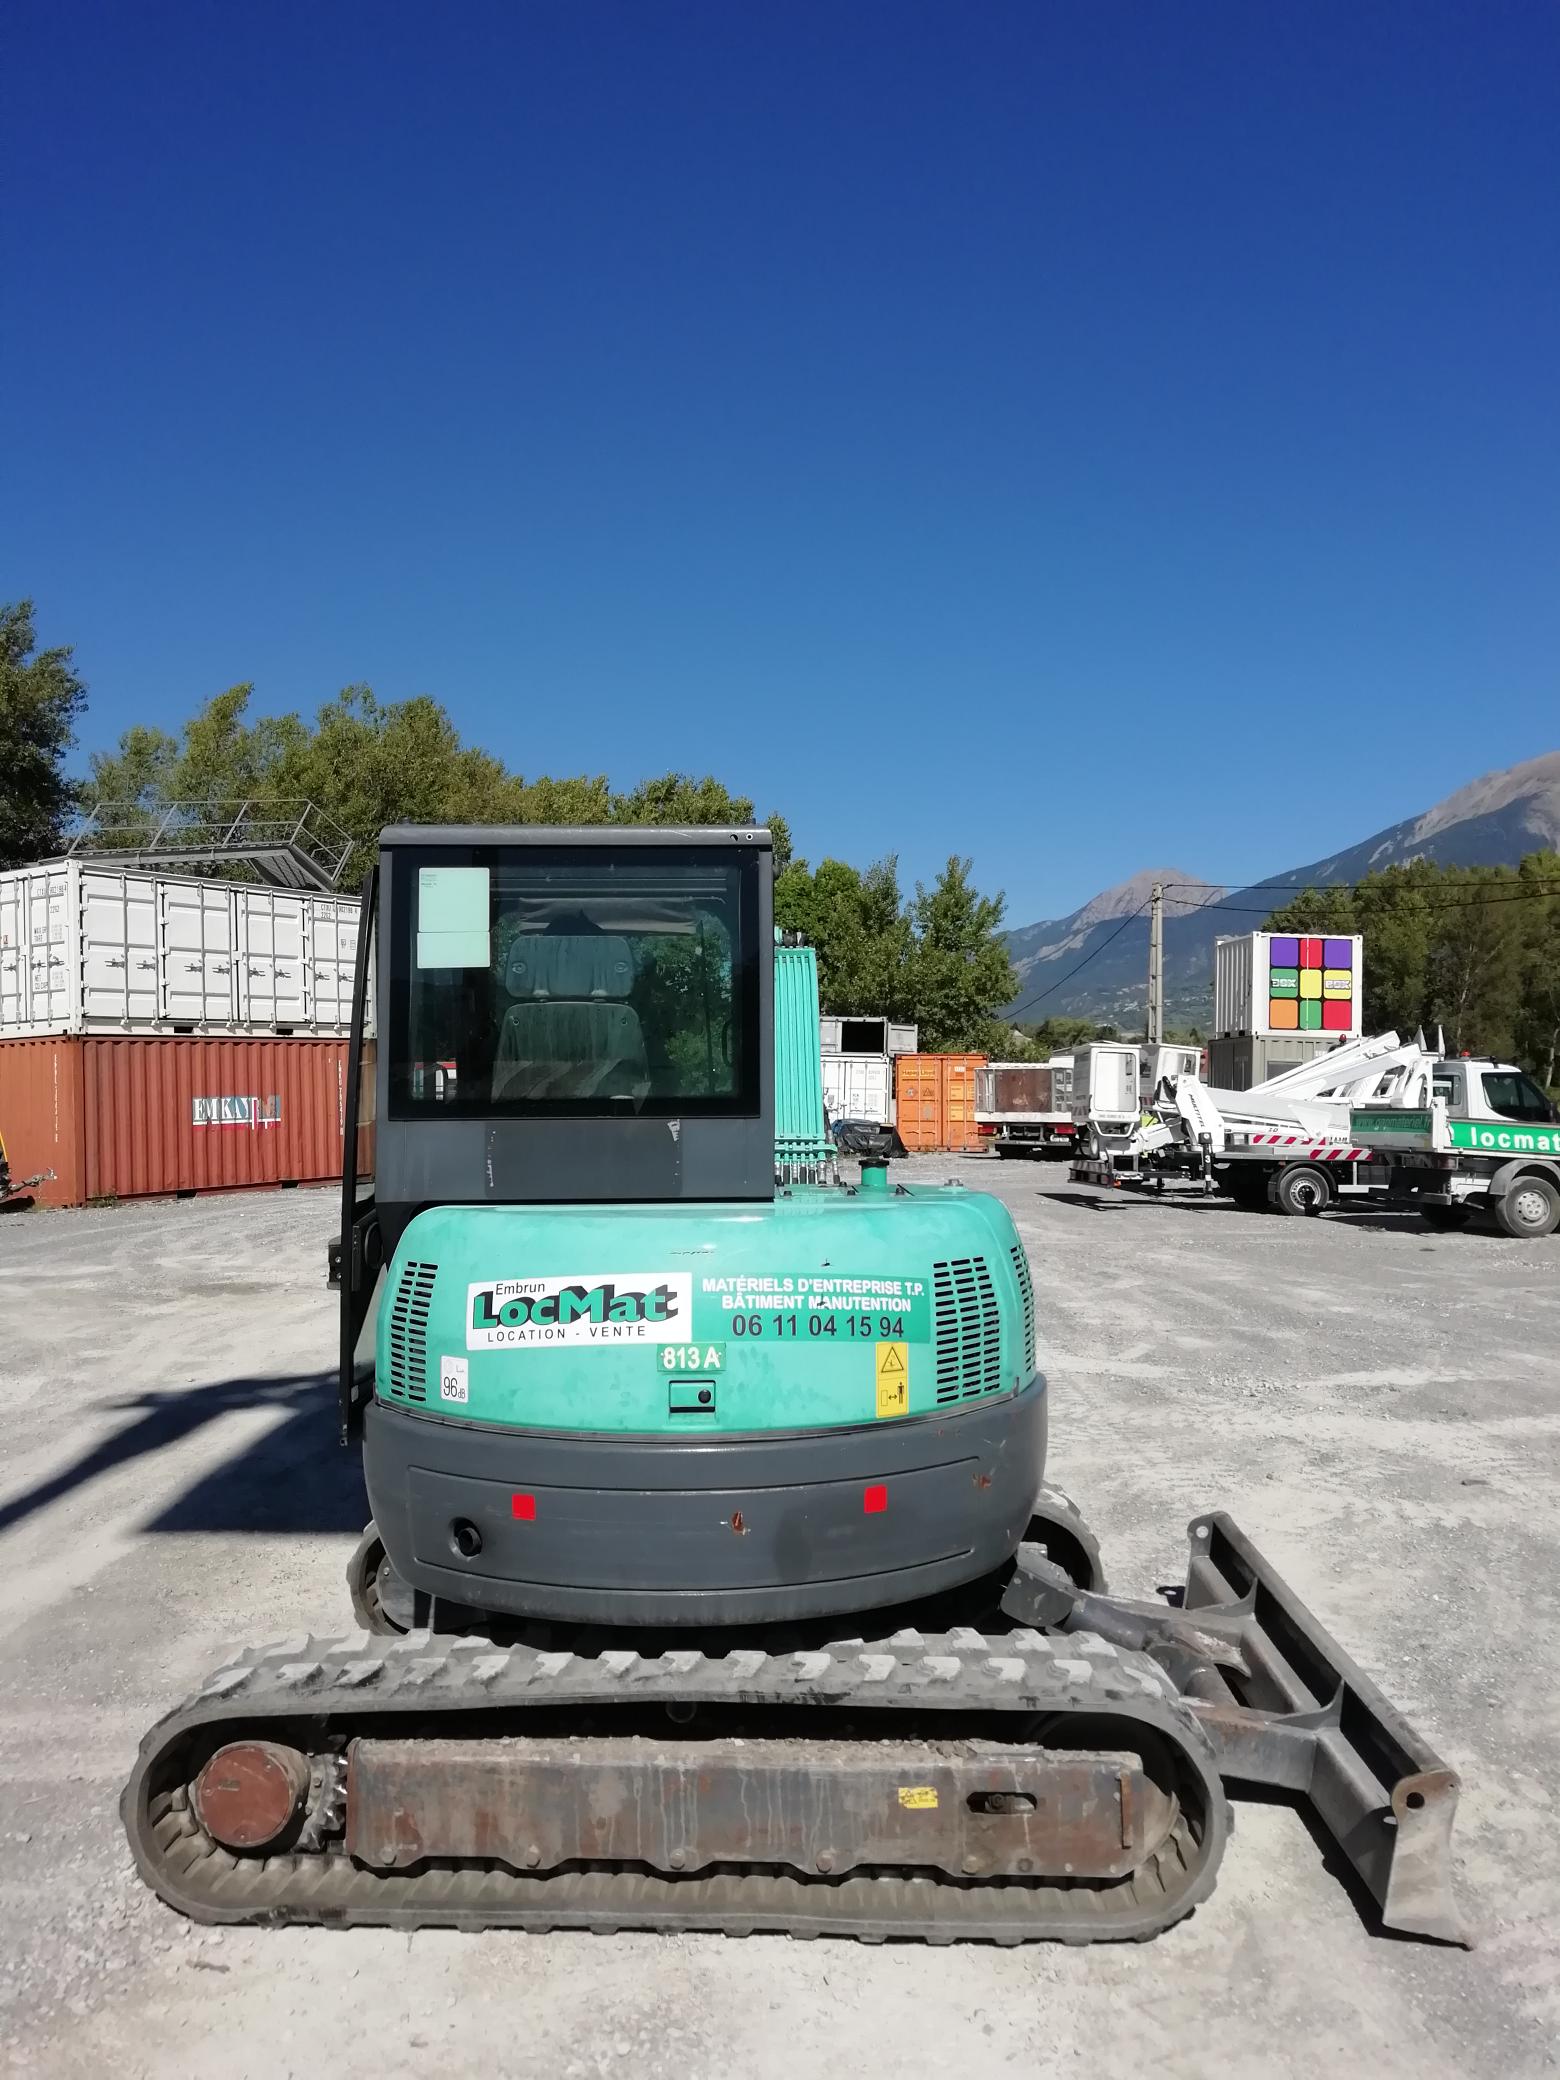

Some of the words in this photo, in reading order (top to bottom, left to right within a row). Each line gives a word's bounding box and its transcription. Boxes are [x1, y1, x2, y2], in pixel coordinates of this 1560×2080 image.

[1204, 1154, 1211, 1164] 3
[495, 1282, 546, 1295] Embrun
[702, 1275, 794, 1292] MATÉRIELS
[798, 1278, 902, 1295] D'ENTREPRISE
[904, 1282, 925, 1297] T.P.
[473, 1284, 679, 1329] LocMat
[721, 1292, 805, 1310] BÂTIMENT
[808, 1295, 912, 1312] MANUTENTION
[487, 1328, 565, 1342] LOCATION
[589, 1325, 646, 1338] VENTE
[732, 1314, 763, 1337] 06
[773, 1314, 797, 1337] 11
[808, 1314, 837, 1337] 04
[846, 1315, 872, 1337] 15
[879, 1316, 904, 1338] 94
[663, 1346, 701, 1369] 813
[703, 1345, 721, 1369] A
[443, 1376, 458, 1398] 96
